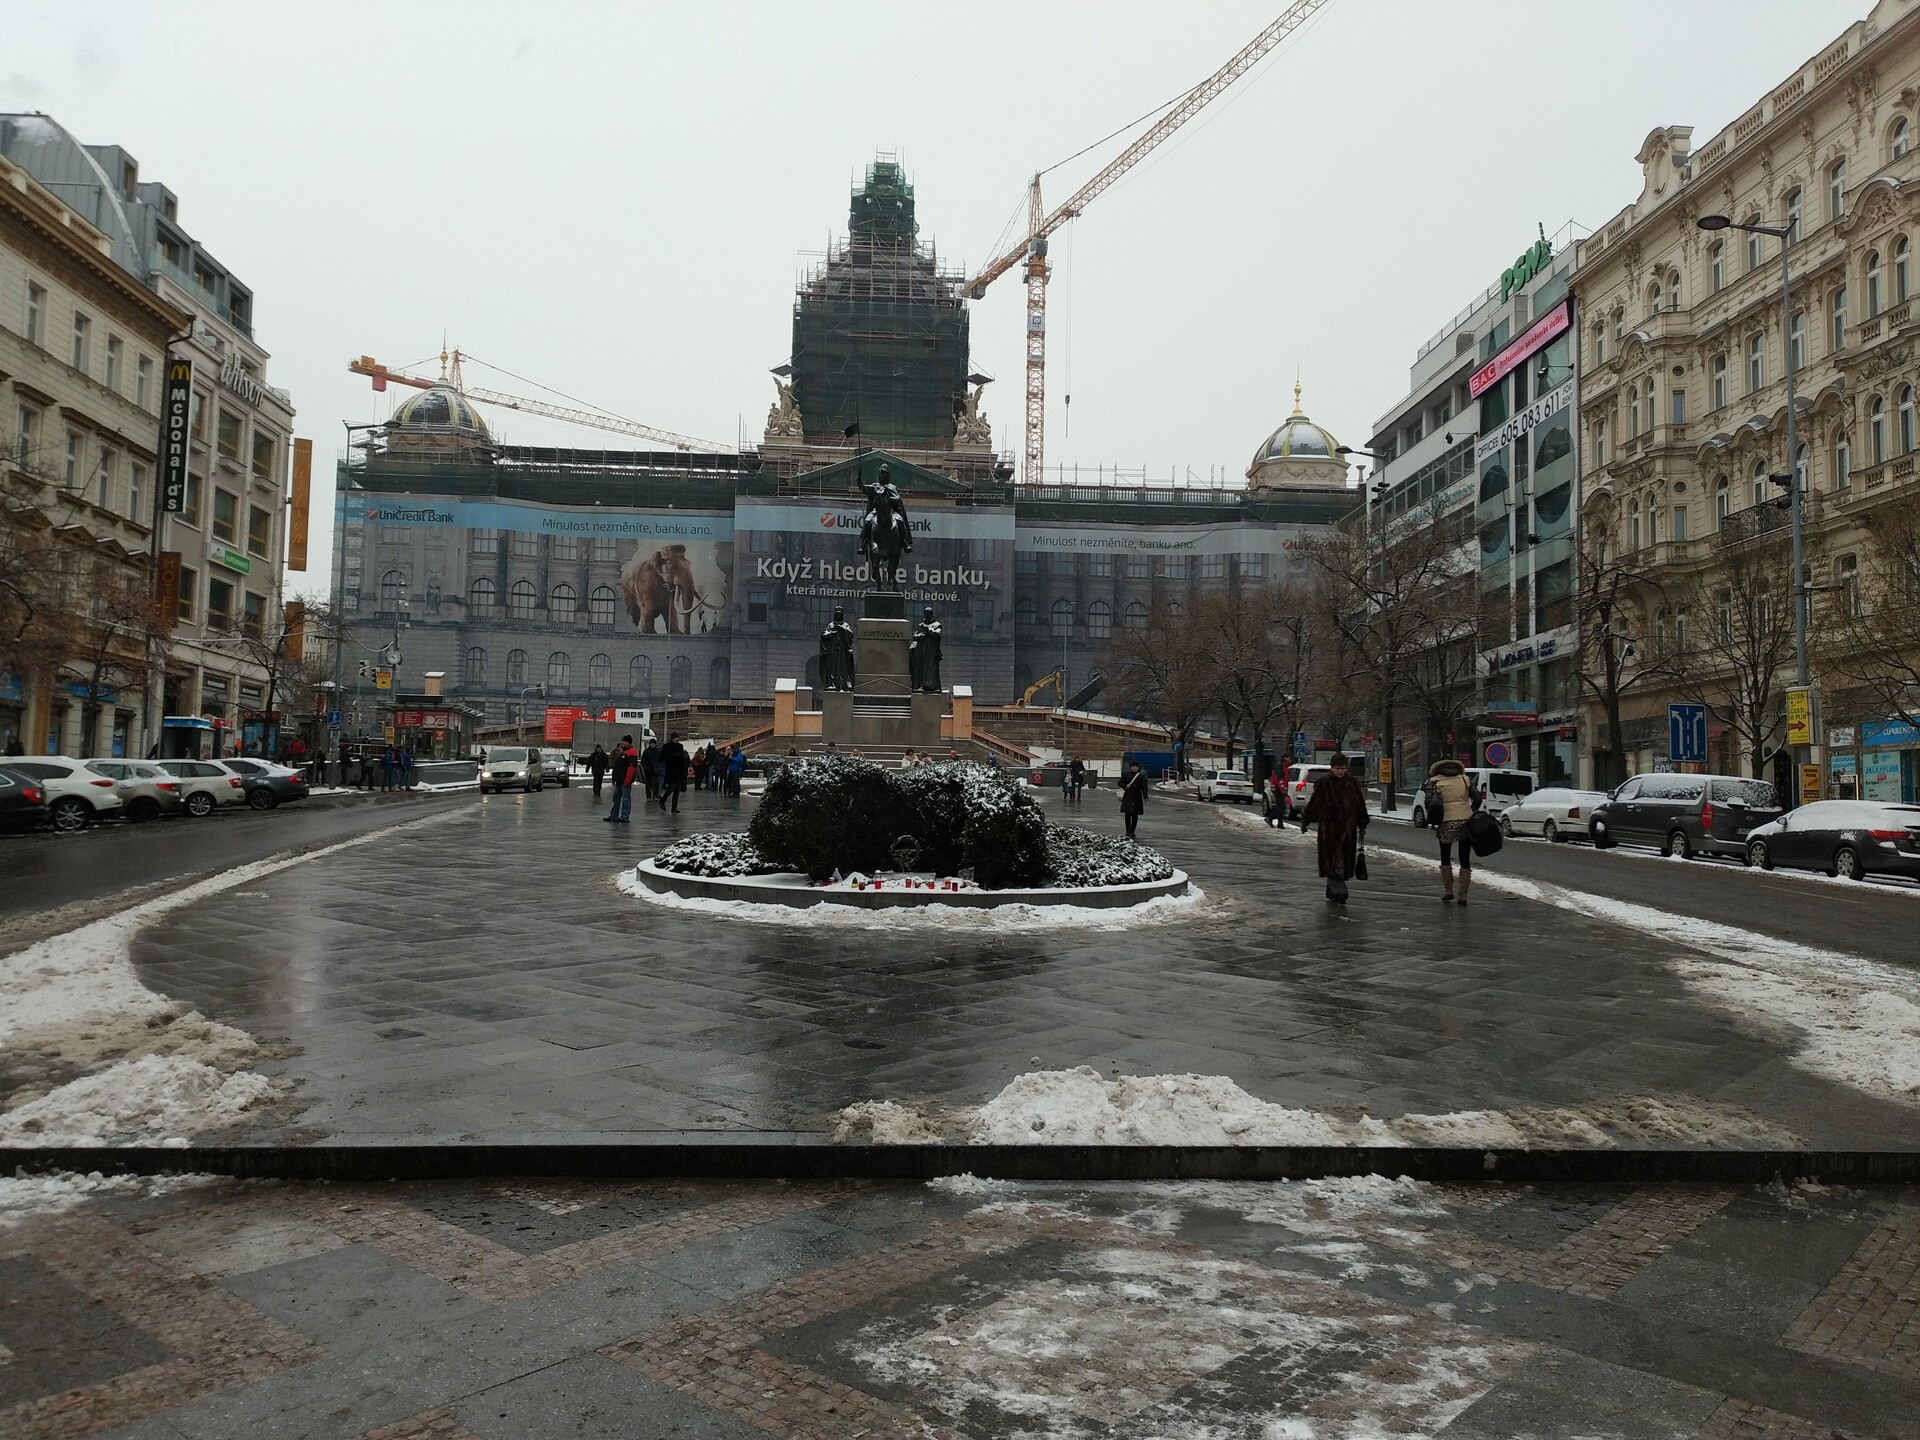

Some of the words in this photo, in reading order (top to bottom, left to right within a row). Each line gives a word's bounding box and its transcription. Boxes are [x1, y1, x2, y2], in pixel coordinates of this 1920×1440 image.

[1501, 240, 1542, 304] PSN
[1472, 364, 1496, 393] BAC
[1562, 382, 1573, 395] FOR
[1562, 391, 1573, 406] RENT
[1477, 436, 1499, 458] OFFICES
[1500, 419, 1519, 446] 605
[1521, 404, 1541, 433] 083
[1544, 391, 1560, 418] 611
[167, 388, 186, 510] McDonald's
[379, 509, 426, 522] UniCredit
[428, 511, 454, 523] Bank
[542, 518, 590, 532] Minulost
[593, 521, 652, 535] nezměníte,
[655, 524, 688, 535] banku
[690, 525, 713, 535] ano.
[907, 518, 932, 532] ank
[1032, 535, 1077, 547] Minulost
[1080, 537, 1137, 550] nezměníte,
[1139, 539, 1171, 550] banku
[1173, 540, 1196, 550] ano.
[757, 557, 813, 584] Když
[915, 563, 990, 591] banku,
[786, 584, 816, 596] která
[920, 590, 960, 602] ledové.
[620, 711, 644, 719] IMOS
[1882, 726, 1916, 736] CURRENCY
